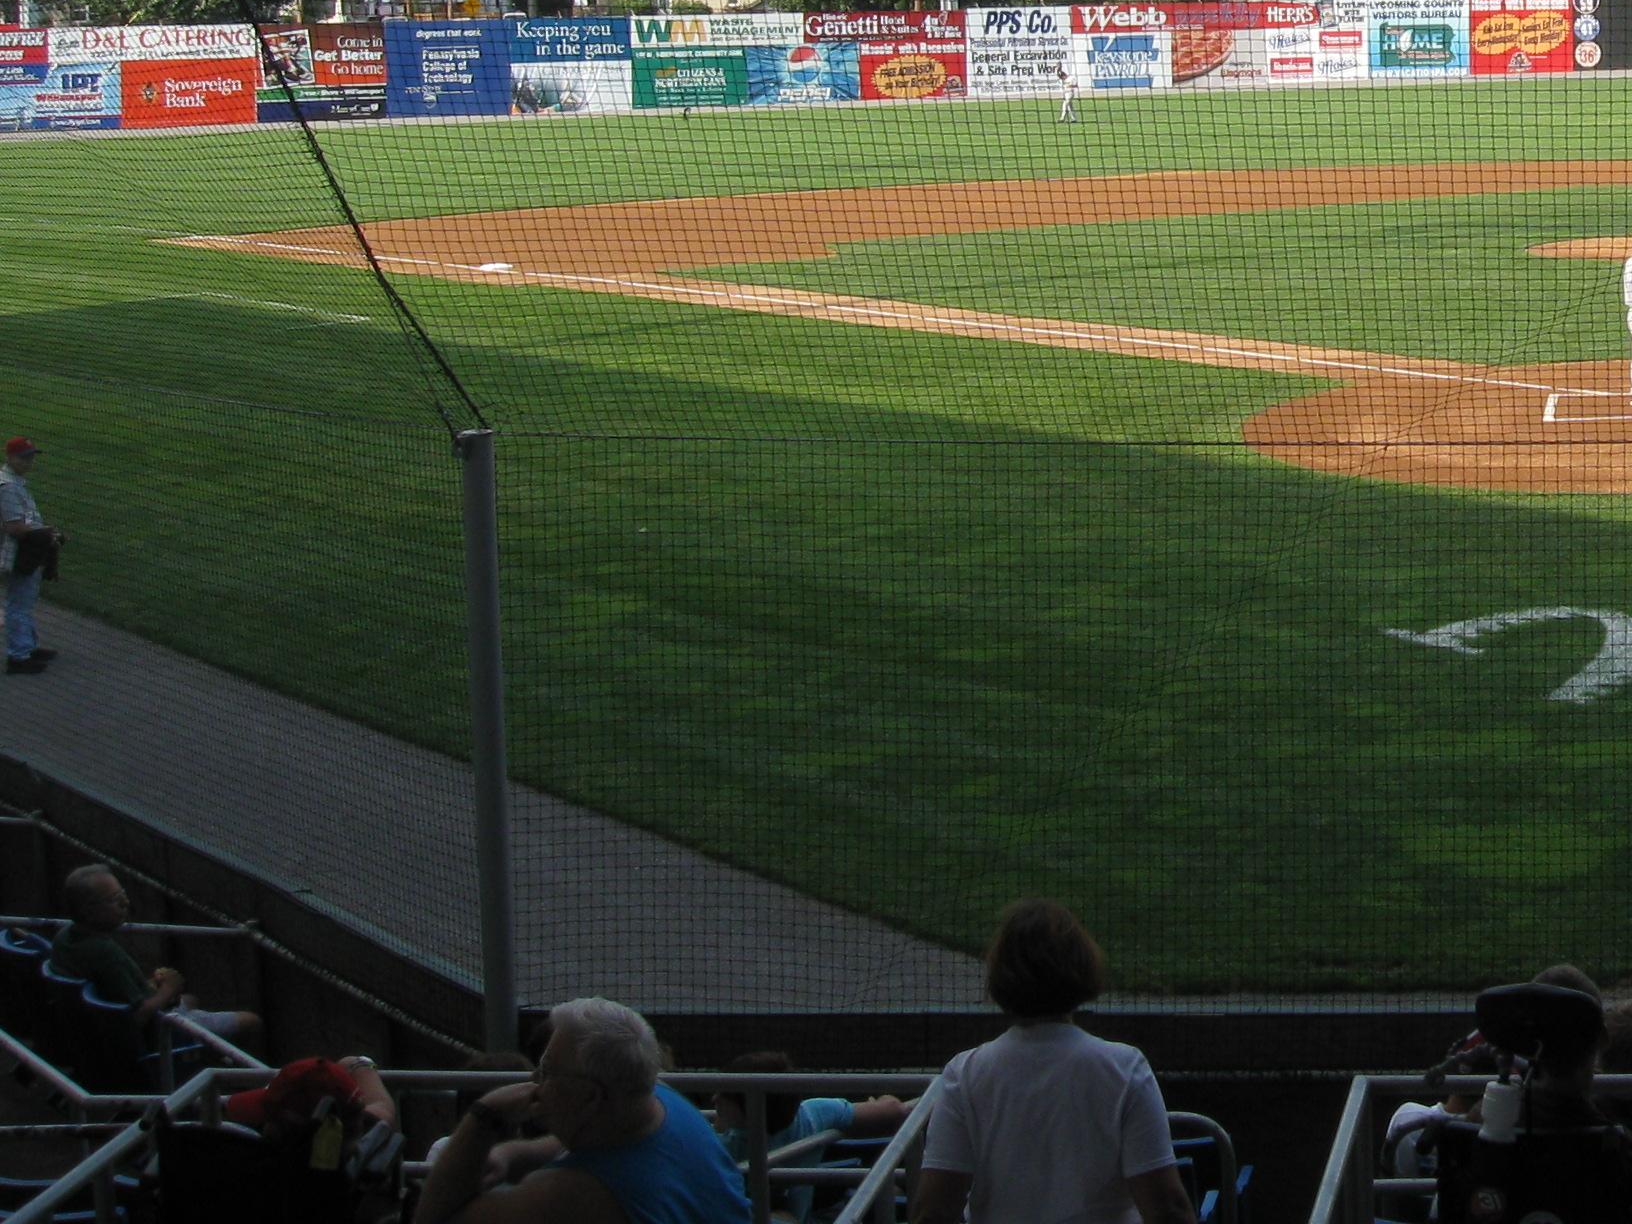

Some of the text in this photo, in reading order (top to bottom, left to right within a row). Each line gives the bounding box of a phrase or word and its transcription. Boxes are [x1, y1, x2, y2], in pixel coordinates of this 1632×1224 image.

[1370, 0, 1464, 9] LYCOMING COUNTY
[1078, 6, 1167, 31] Webb
[1267, 6, 1314, 23] HERR'S
[1373, 10, 1461, 19] VISITORS BUREAU
[710, 18, 754, 26] WASTE
[806, 15, 879, 36] Genetti
[985, 10, 1022, 34] PPS
[1029, 10, 1057, 33] Co.
[516, 21, 611, 43] Keeping you
[634, 18, 707, 43] WM
[710, 27, 800, 36] MANAGEMENT
[1581, 23, 1593, 36] 41
[82, 28, 250, 50] D&L CATERING
[337, 35, 383, 48] Come in
[314, 50, 383, 61] Get Better
[422, 49, 480, 61] Pennsylvania
[536, 41, 551, 56] in
[556, 38, 581, 55] the
[584, 43, 625, 60] game
[972, 51, 1067, 63] General Excavation
[1580, 49, 1594, 64] 36
[331, 63, 384, 75] Go home
[422, 61, 455, 73] College
[976, 66, 984, 75] &
[989, 65, 1007, 75] Site
[1011, 65, 1033, 76] Prep
[164, 77, 242, 96] Sovereign
[165, 93, 206, 107] Bank
